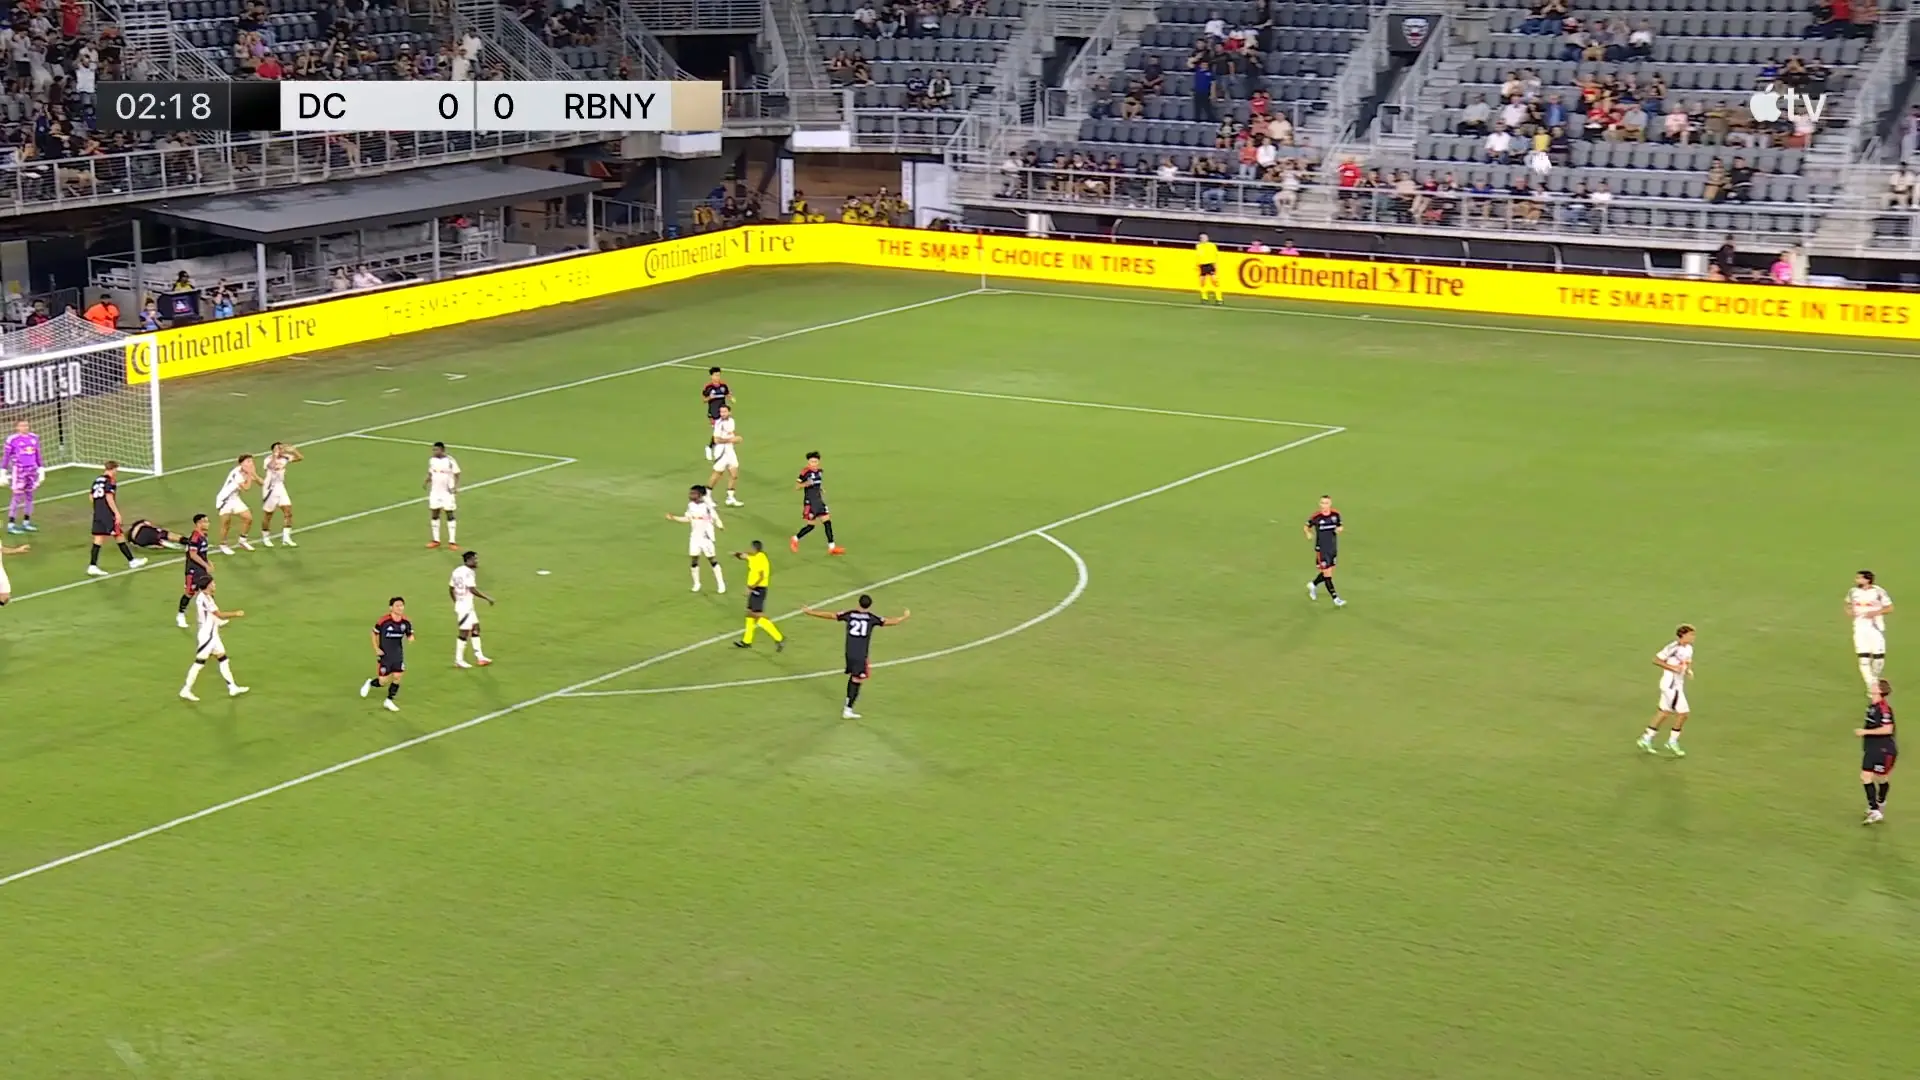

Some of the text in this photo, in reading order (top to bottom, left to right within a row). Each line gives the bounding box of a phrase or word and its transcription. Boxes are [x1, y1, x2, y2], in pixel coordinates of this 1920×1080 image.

[644, 229, 795, 279] Continental Tire
[878, 239, 913, 257] THE
[991, 248, 1064, 268] CHOICE
[1072, 254, 1093, 270] IN
[1101, 255, 1157, 275] TIRES
[1238, 257, 1465, 297] Continental Tire
[1558, 287, 1910, 324] THE SMART CHOICE IN TIRES
[131, 314, 317, 375] Continental Tire
[4, 361, 82, 405] UNITED
[850, 619, 868, 637] 21
